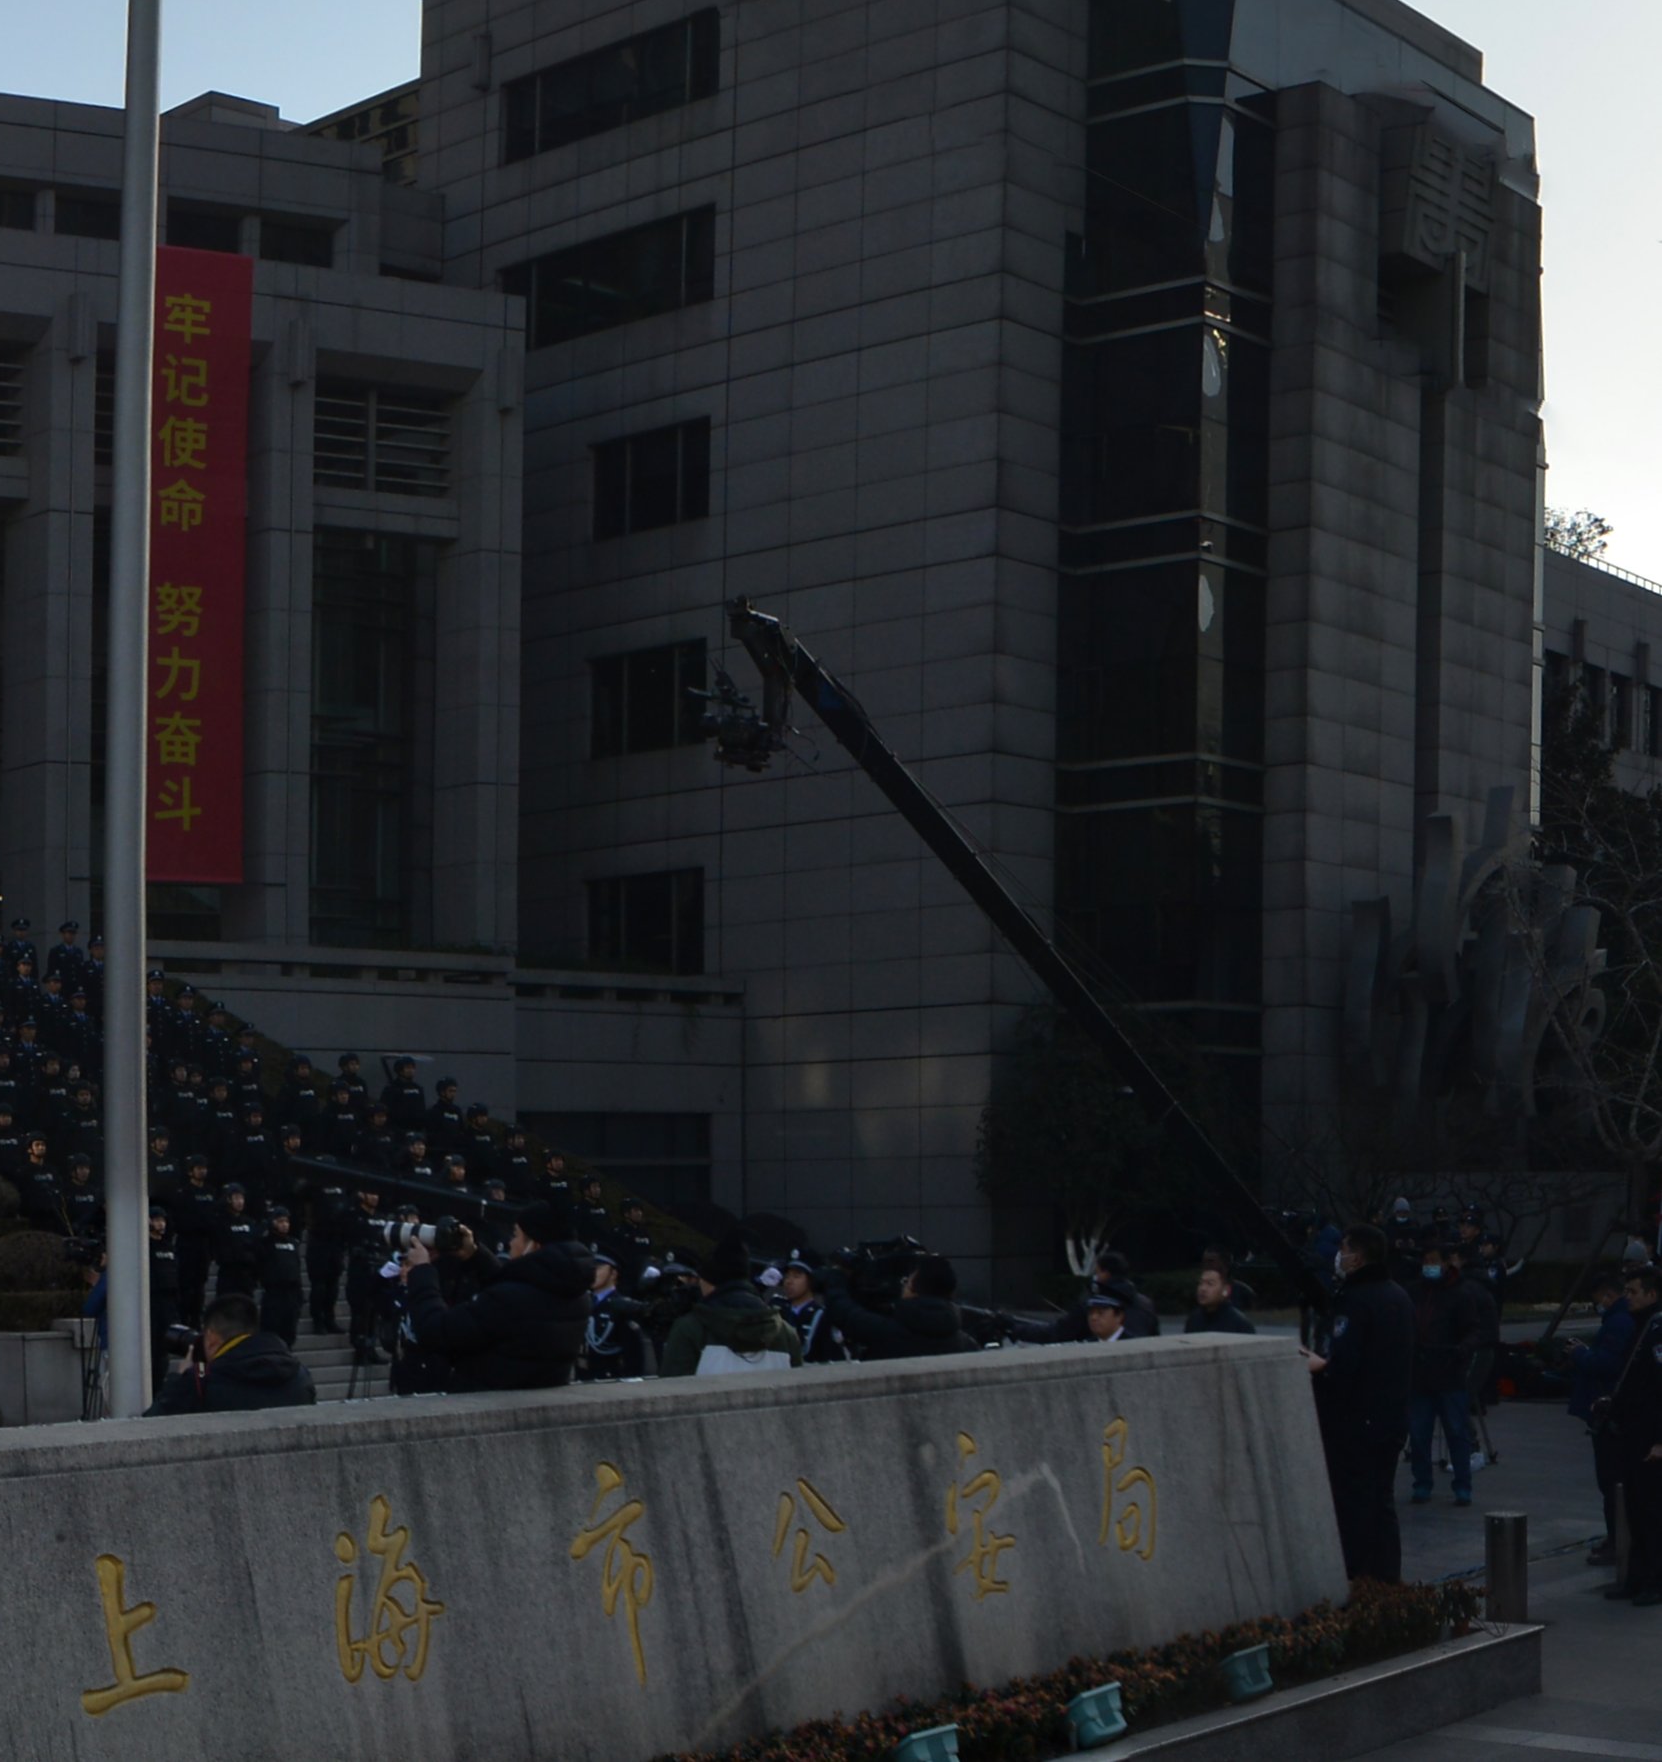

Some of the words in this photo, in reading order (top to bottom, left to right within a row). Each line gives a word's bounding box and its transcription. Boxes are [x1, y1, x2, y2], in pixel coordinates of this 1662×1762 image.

[157, 292, 214, 532] 牢记使命
[154, 582, 204, 832] 努力奋斗
[80, 1415, 1156, 1717] 上海市公安局
